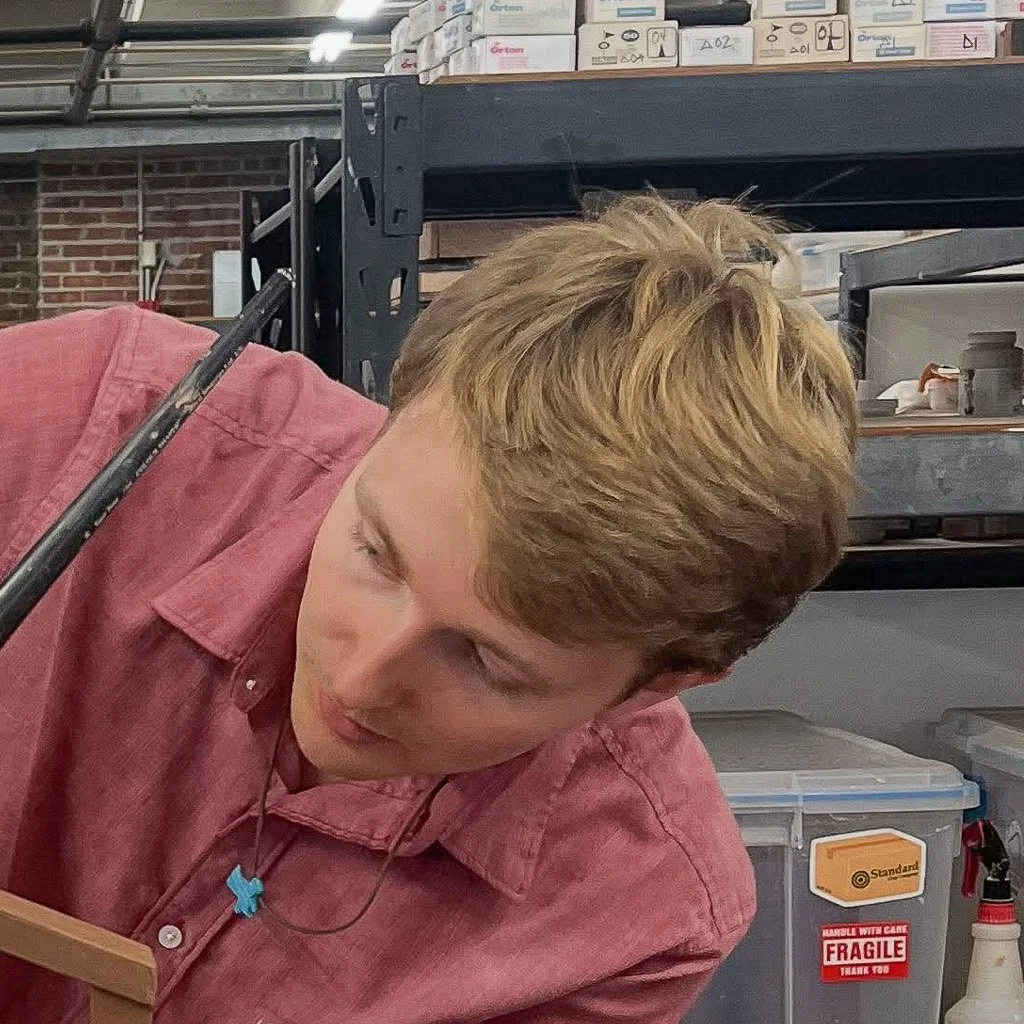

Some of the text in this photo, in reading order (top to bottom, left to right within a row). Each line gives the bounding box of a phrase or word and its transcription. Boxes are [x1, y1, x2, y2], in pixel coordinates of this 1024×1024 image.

[870, 861, 919, 879] Standard
[822, 924, 908, 937] HANDLE WITH CARE
[826, 940, 904, 962] FRAGILE
[840, 965, 890, 976] THANK YOU
